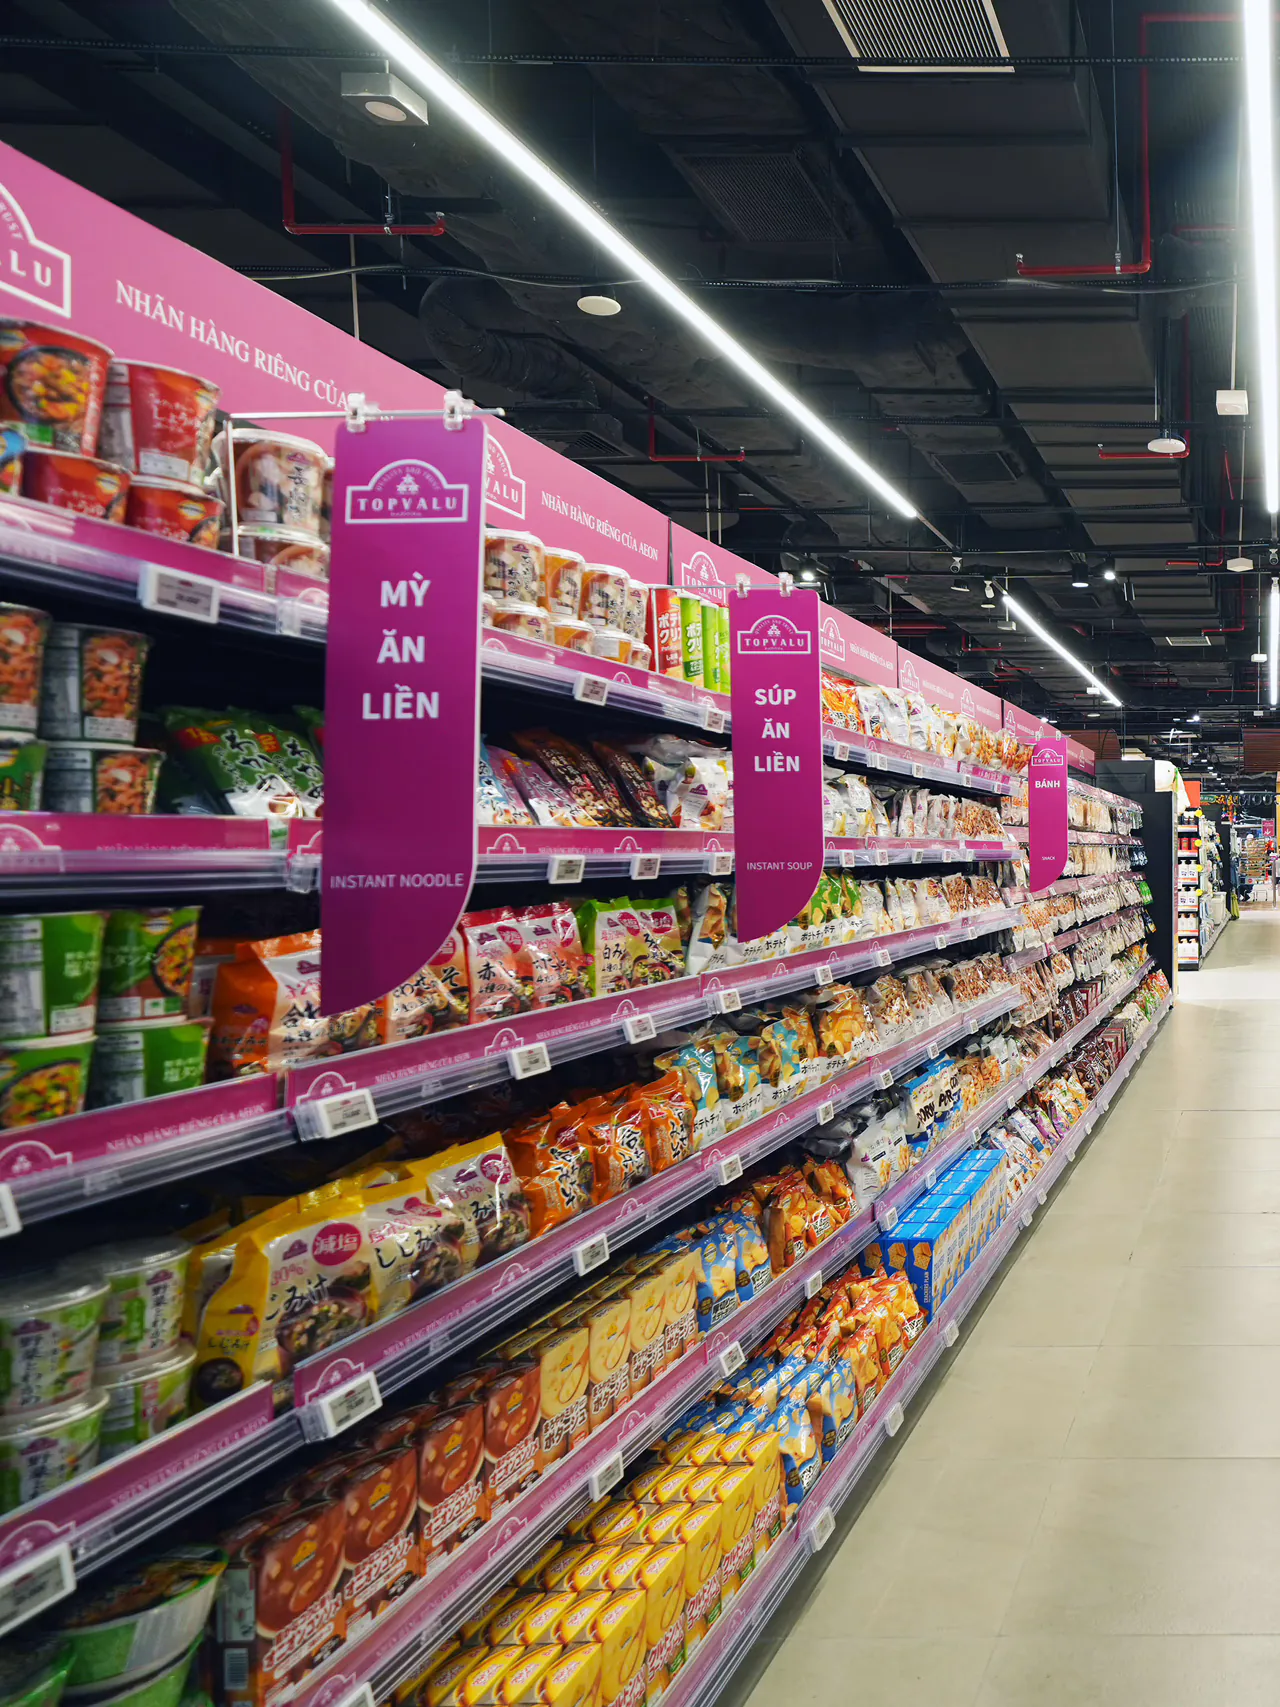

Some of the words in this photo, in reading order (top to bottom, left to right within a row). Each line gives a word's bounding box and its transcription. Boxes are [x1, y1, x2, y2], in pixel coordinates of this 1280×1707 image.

[116, 279, 185, 333] NHÃN
[190, 316, 250, 363] HÀNG
[254, 347, 311, 392] RIÊNG
[314, 379, 350, 412] CỦA
[356, 497, 458, 511] TOPVALU
[541, 490, 569, 518] NHÃN
[570, 505, 596, 531] HÀNG
[596, 519, 621, 544] RIÊNG
[621, 532, 638, 551] CỦA
[638, 542, 659, 562] AEON
[380, 571, 432, 608] MỲ
[376, 628, 426, 664] ĂN
[744, 638, 805, 647] TOPVALU
[362, 683, 440, 720] LIỀN
[754, 684, 797, 706] SÚP
[761, 718, 791, 739] ĂN
[754, 751, 801, 772] LIỀN
[1035, 778, 1061, 789] BÁNH
[746, 861, 785, 870] INSTANT
[787, 861, 813, 870] SOUP
[330, 874, 396, 889] INSTANT
[400, 872, 465, 887] NOODLE
[314, 1233, 359, 1257] 減塩
